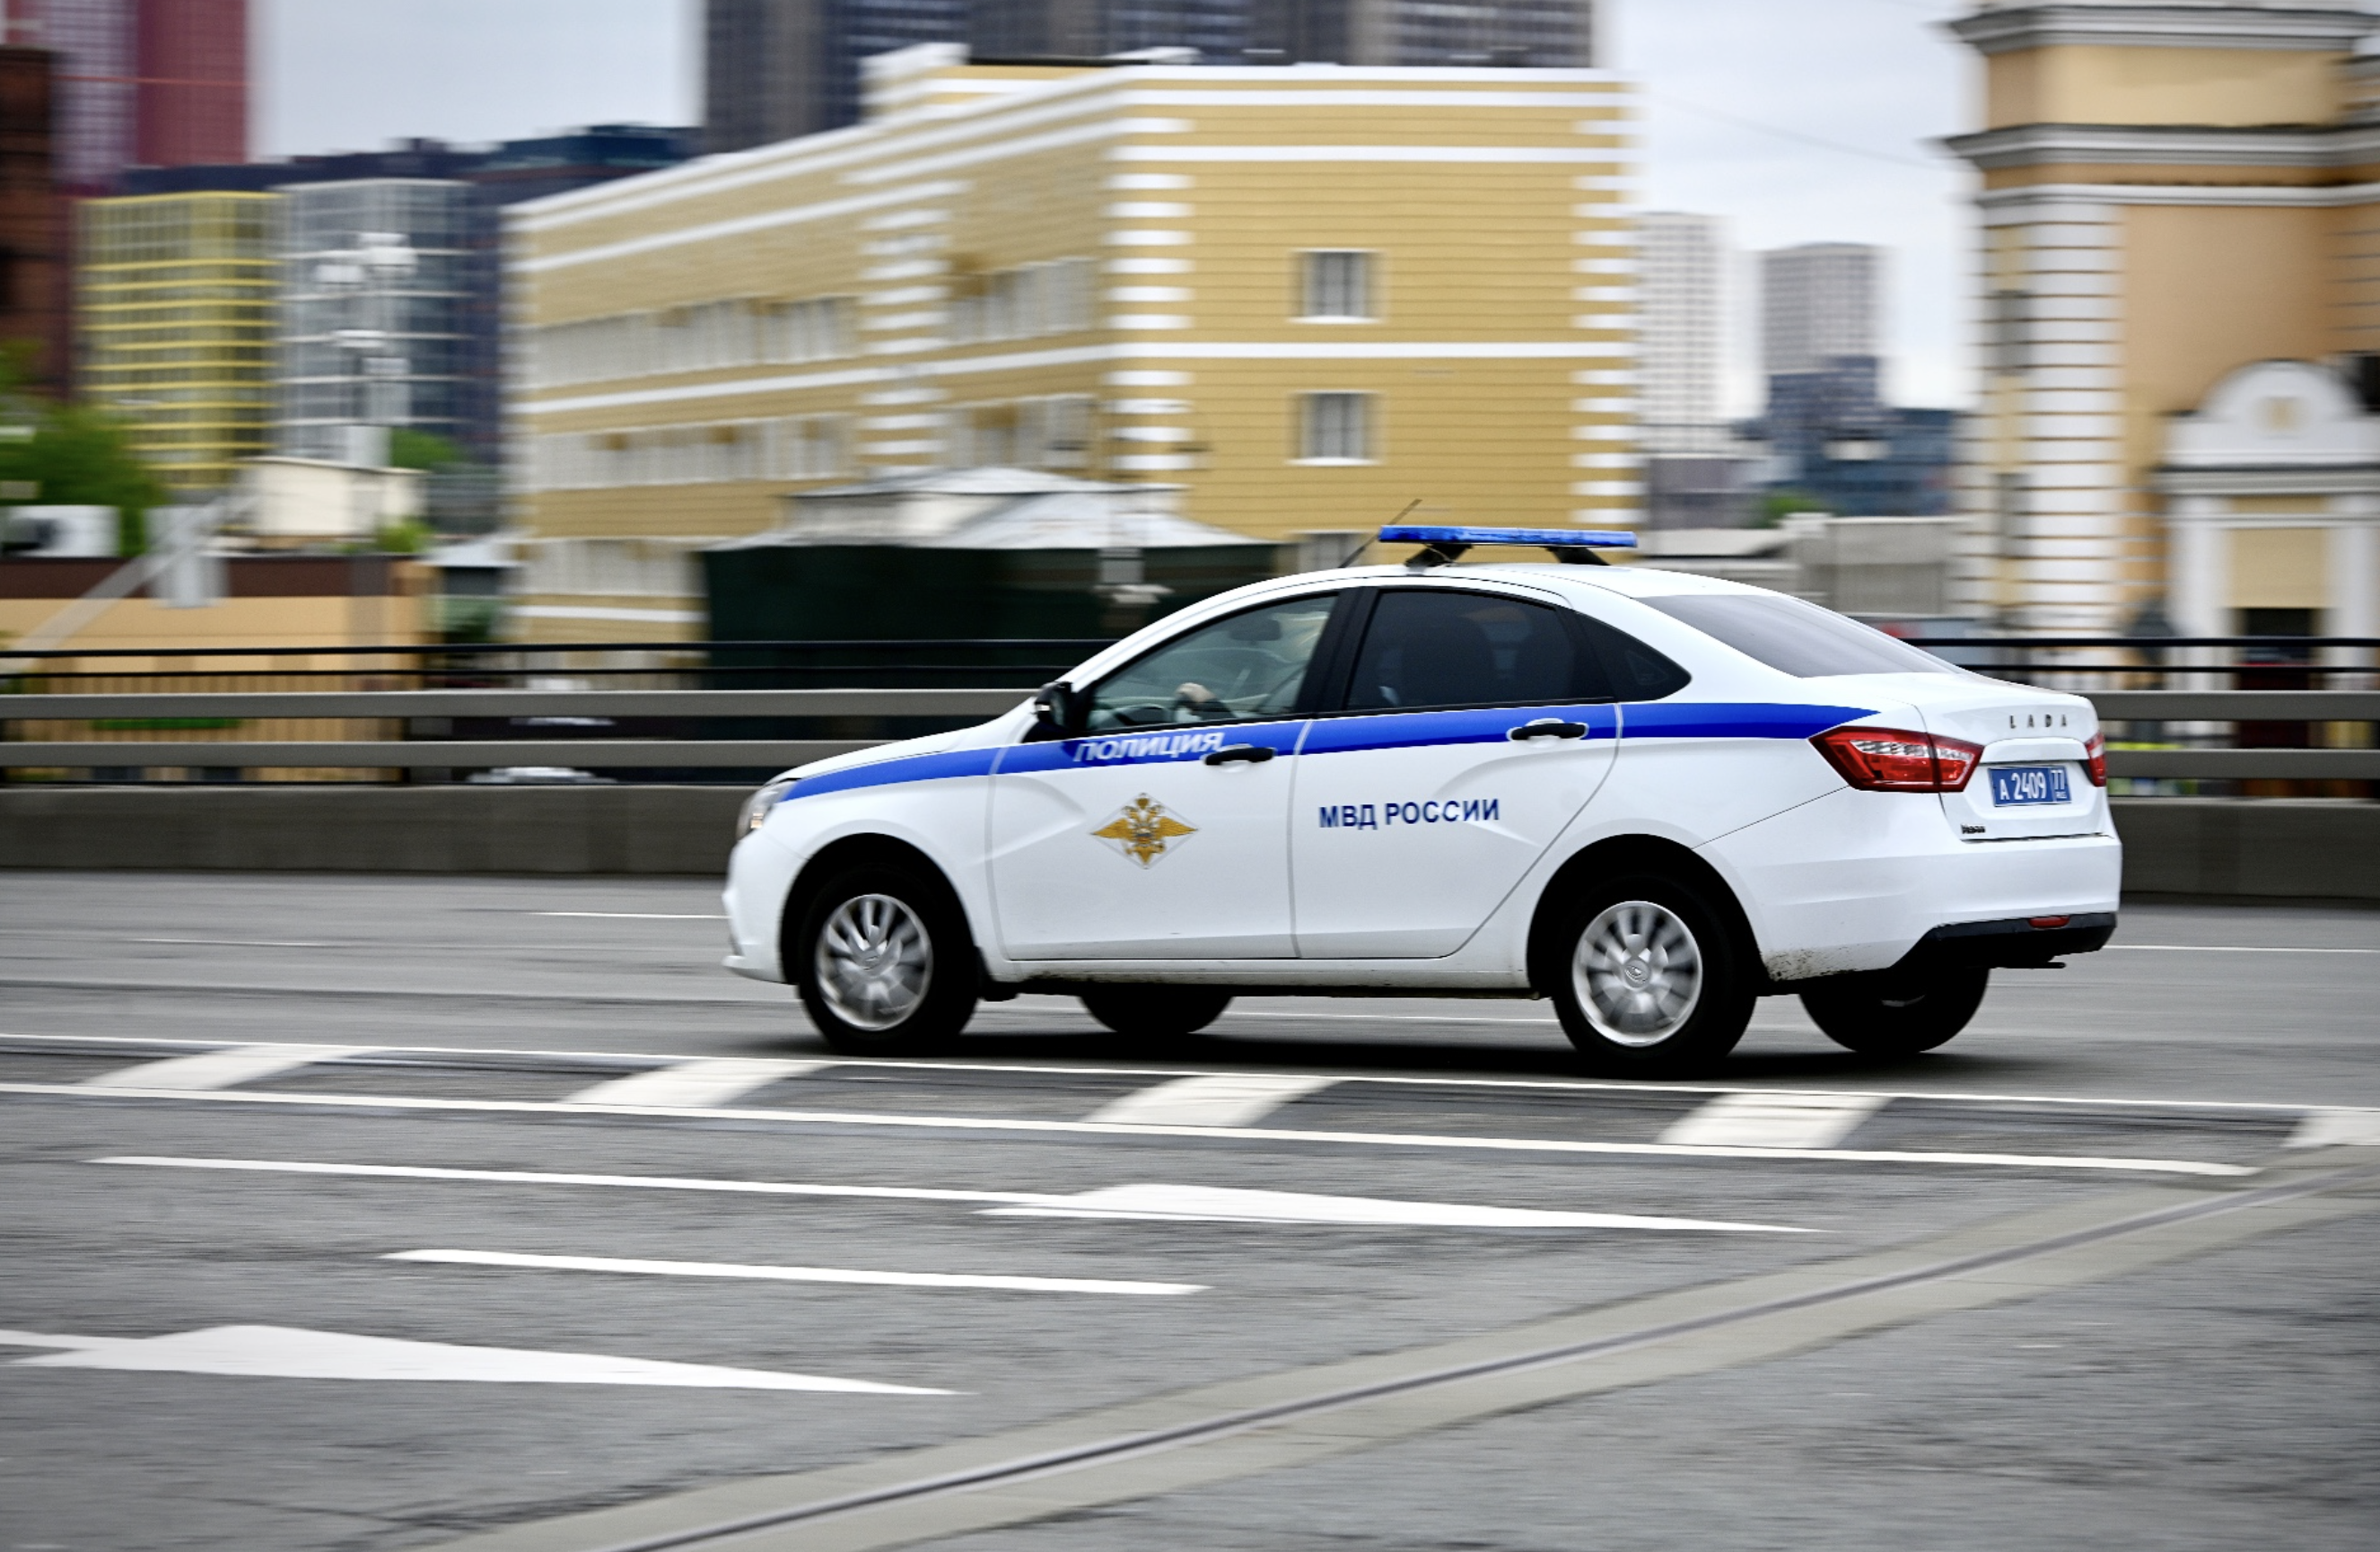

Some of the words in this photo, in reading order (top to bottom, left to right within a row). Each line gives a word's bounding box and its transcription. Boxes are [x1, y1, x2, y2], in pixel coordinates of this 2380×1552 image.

[2008, 714, 2068, 729] LADA
[1072, 731, 1226, 763] ПОЛИЦИЯ
[2010, 771, 2047, 800] 2409
[2050, 769, 2066, 790] 77
[1319, 803, 1378, 831] МВД
[1385, 798, 1500, 826] РОССИИ
